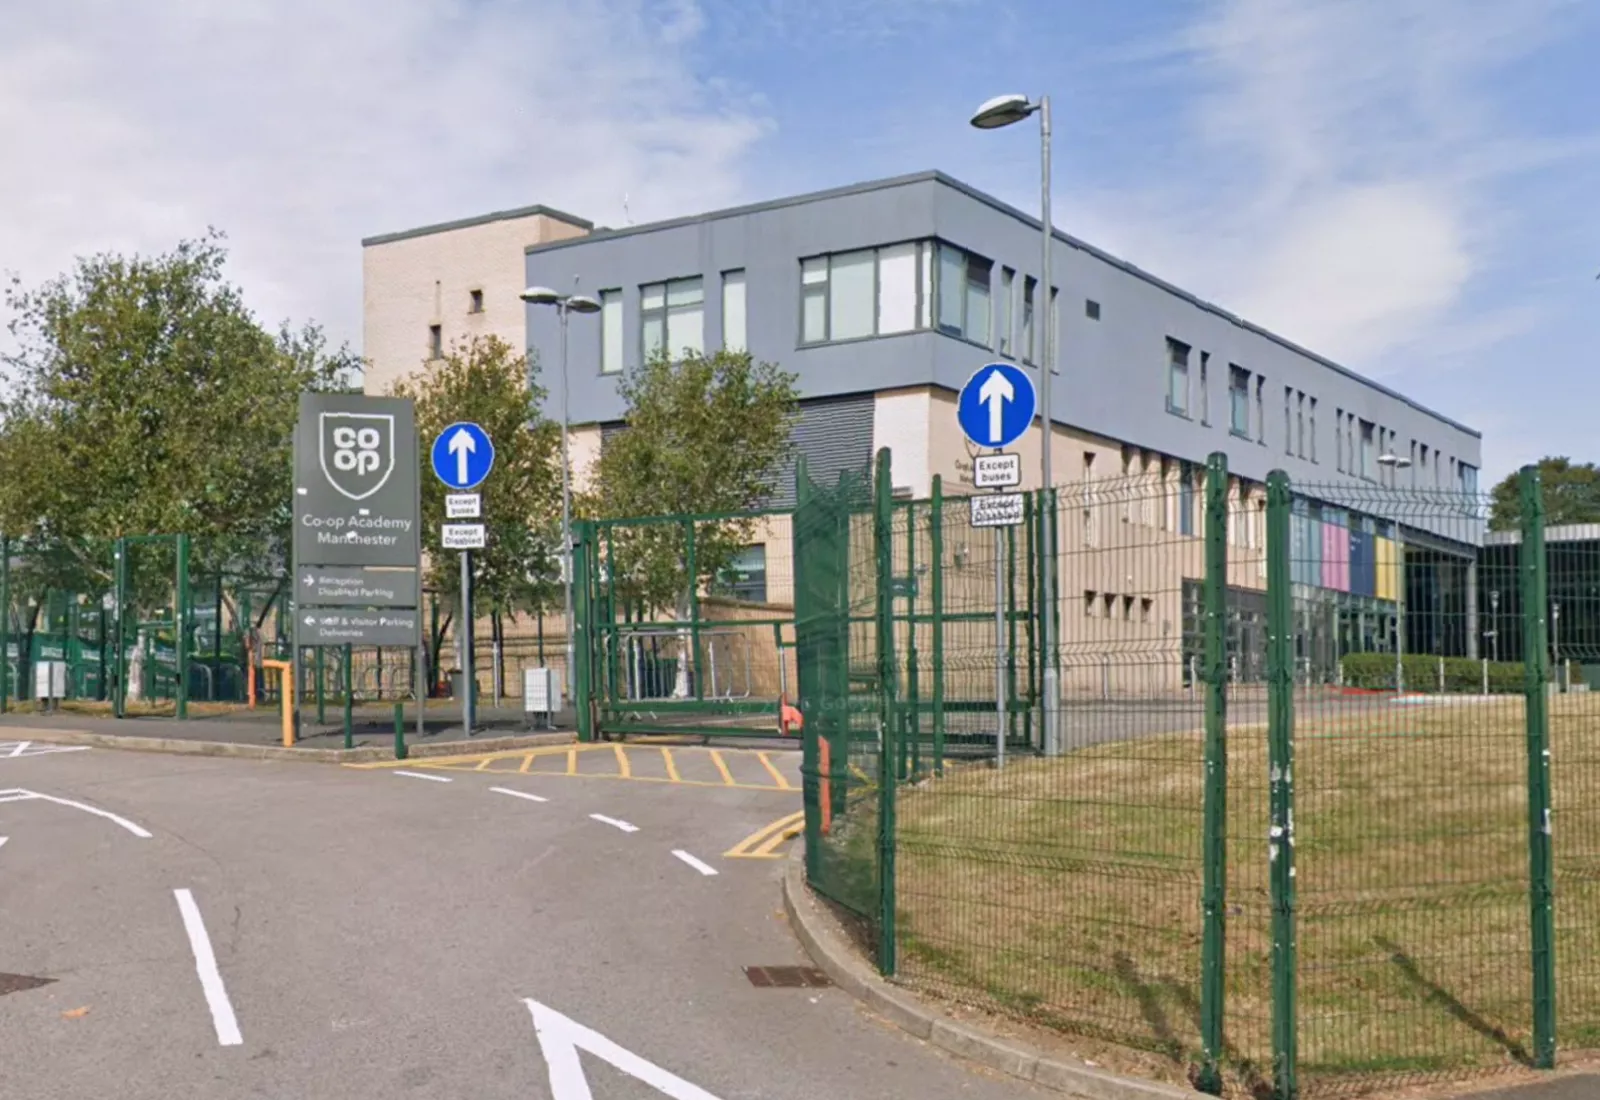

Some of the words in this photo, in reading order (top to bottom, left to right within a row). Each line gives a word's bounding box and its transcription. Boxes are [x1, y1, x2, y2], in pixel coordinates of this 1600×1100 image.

[979, 460, 1014, 471] Except
[981, 473, 1011, 482] buses
[302, 514, 345, 530] Co-op
[347, 516, 412, 532] Academy
[317, 532, 398, 545] Manchester
[360, 588, 394, 599] Parking
[380, 617, 414, 629] Parking
